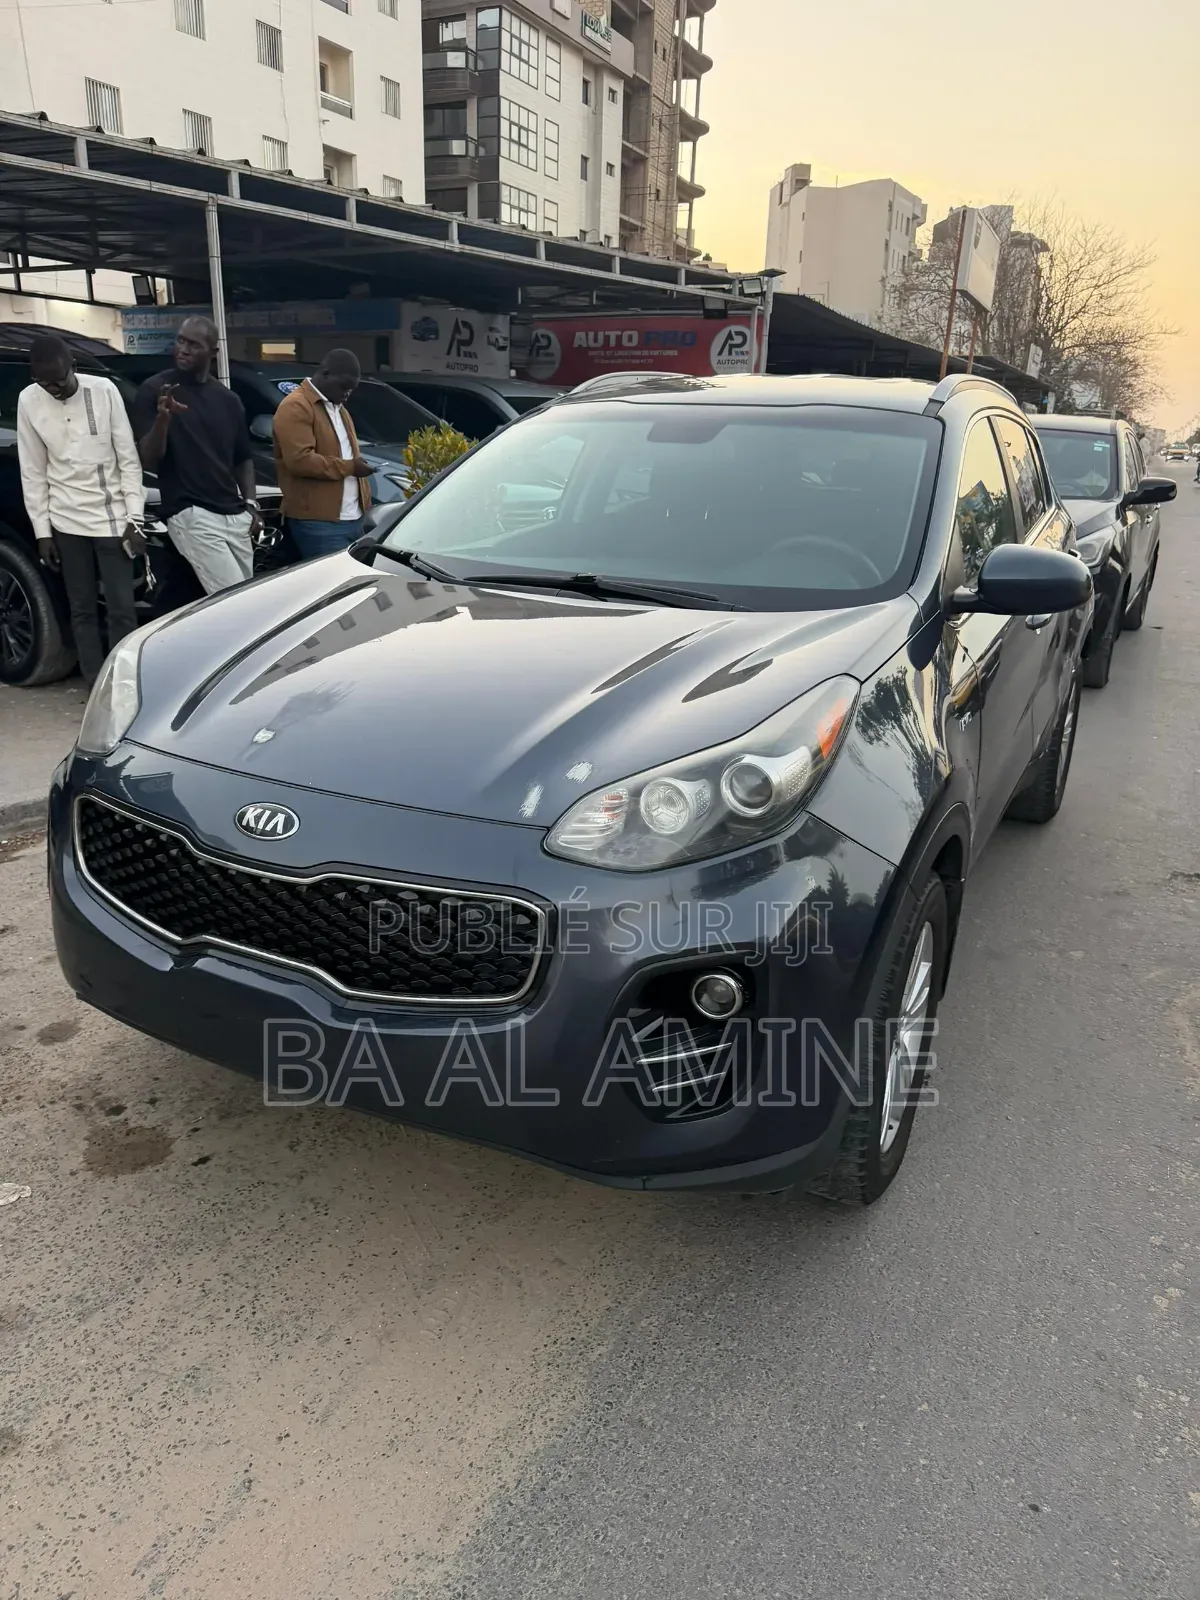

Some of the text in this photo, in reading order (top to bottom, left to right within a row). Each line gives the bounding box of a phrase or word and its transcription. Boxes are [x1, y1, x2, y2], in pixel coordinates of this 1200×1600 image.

[572, 330, 697, 348] AUTO PRO
[445, 361, 479, 373] AUTOPRO
[241, 806, 286, 834] KIA
